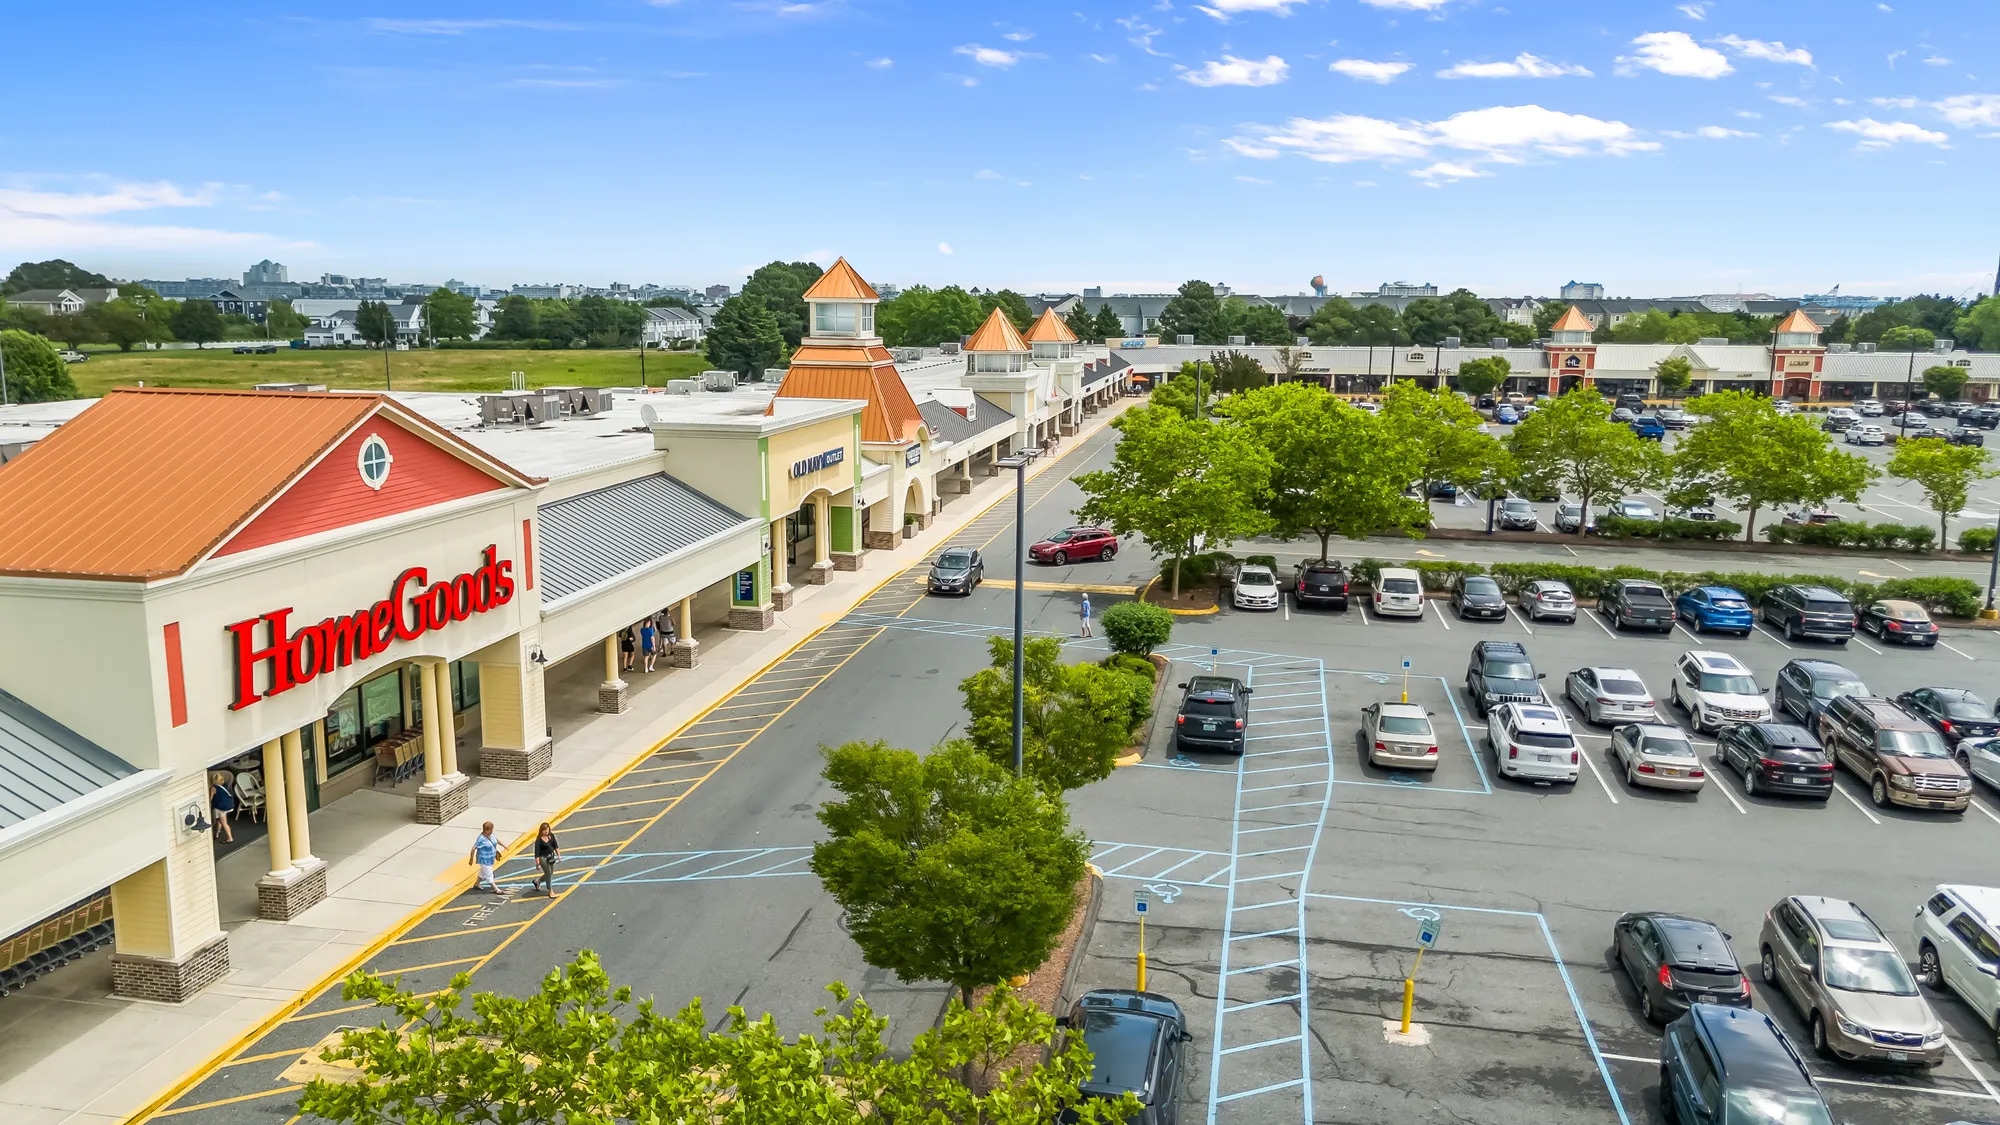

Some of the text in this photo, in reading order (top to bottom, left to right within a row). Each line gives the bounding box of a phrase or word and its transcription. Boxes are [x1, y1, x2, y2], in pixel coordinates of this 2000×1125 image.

[1427, 367, 1451, 375] HOME
[794, 451, 842, 479] OLD NAVY OUTLET
[225, 544, 514, 711] HomeGoods
[462, 906, 498, 926] FIRE
